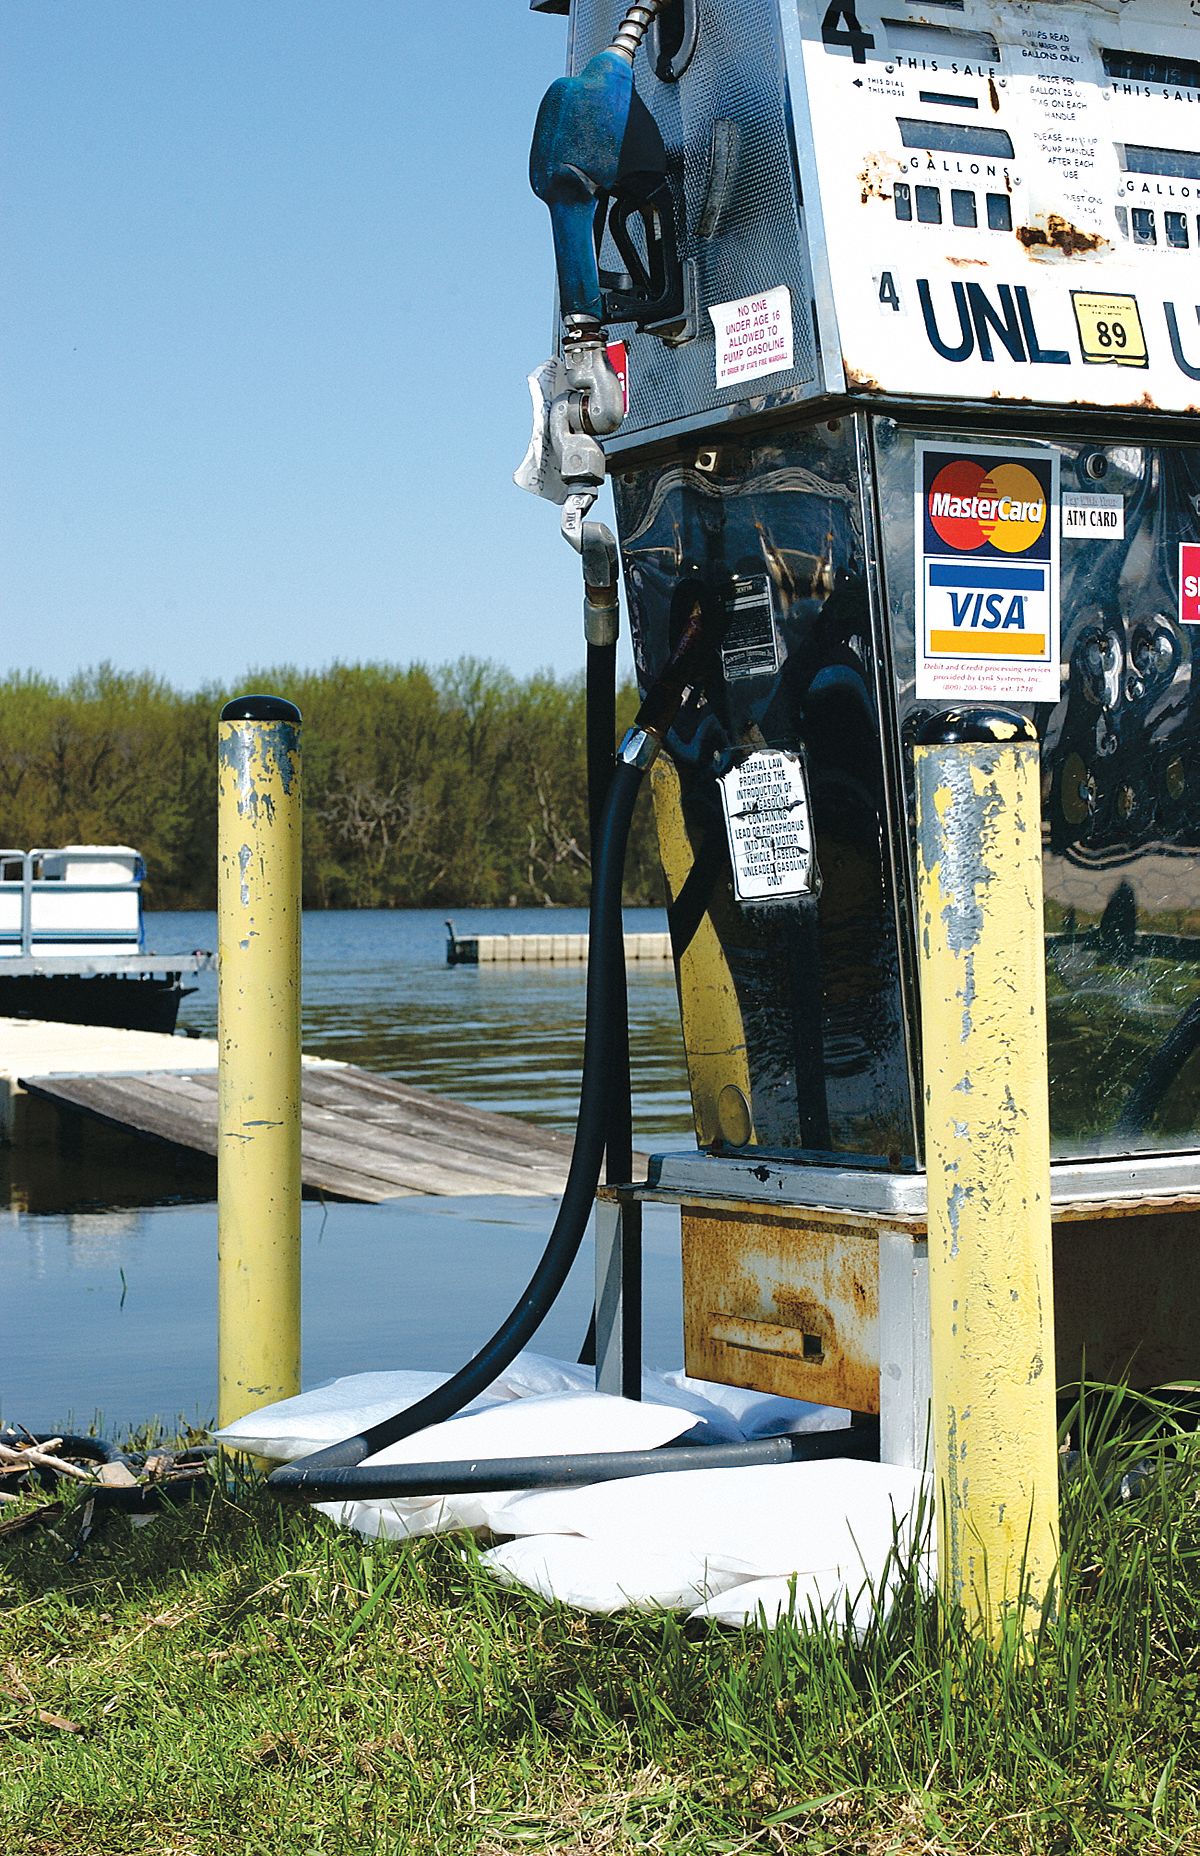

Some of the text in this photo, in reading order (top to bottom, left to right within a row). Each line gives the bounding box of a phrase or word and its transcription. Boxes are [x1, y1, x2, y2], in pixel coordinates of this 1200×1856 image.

[822, 0, 875, 64] 4
[1022, 30, 1070, 42] PUMPS READ
[1022, 50, 1058, 60] GALLONS
[896, 56, 995, 78] THIS SALE
[1038, 74, 1074, 85] PRICE PER
[1030, 86, 1060, 95] GALLON
[1064, 88, 1072, 96] IS
[1112, 83, 1150, 97] THIS
[1067, 101, 1087, 109] EACH
[1045, 112, 1076, 120] HANDLE
[1034, 133, 1062, 142] PLEASE
[1042, 144, 1095, 157] PUMP HANDLE
[911, 157, 1009, 177] GALLONS
[1048, 157, 1094, 168] AFTER EACH
[1063, 171, 1078, 179] USE
[879, 272, 899, 311] 4
[738, 299, 768, 317] NO ONE
[726, 310, 780, 335] UNDER AGE 16
[916, 278, 1071, 364] UNL
[729, 325, 778, 348] ALLOWED TO
[1096, 321, 1127, 348] 89
[724, 337, 784, 364] PUMP GASOLINE
[931, 492, 1043, 523] MasterCard
[1066, 510, 1117, 527] ATM CARD
[946, 592, 1025, 629] VISA
[985, 665, 1021, 673] processing
[740, 758, 782, 774] FEDERAL LAW
[739, 770, 786, 787] PROHIBITS THE
[736, 782, 792, 800] INTRODUCTION OF
[743, 796, 789, 810] ANY GASOLINE
[748, 810, 788, 825] CONTAINING
[735, 820, 804, 839] LEAD OR PHOSPHORUS
[744, 840, 758, 850] INTO
[775, 834, 798, 847] MOTOR
[746, 848, 800, 864] VEHICLE LABELED
[776, 859, 808, 872] GASOLINE
